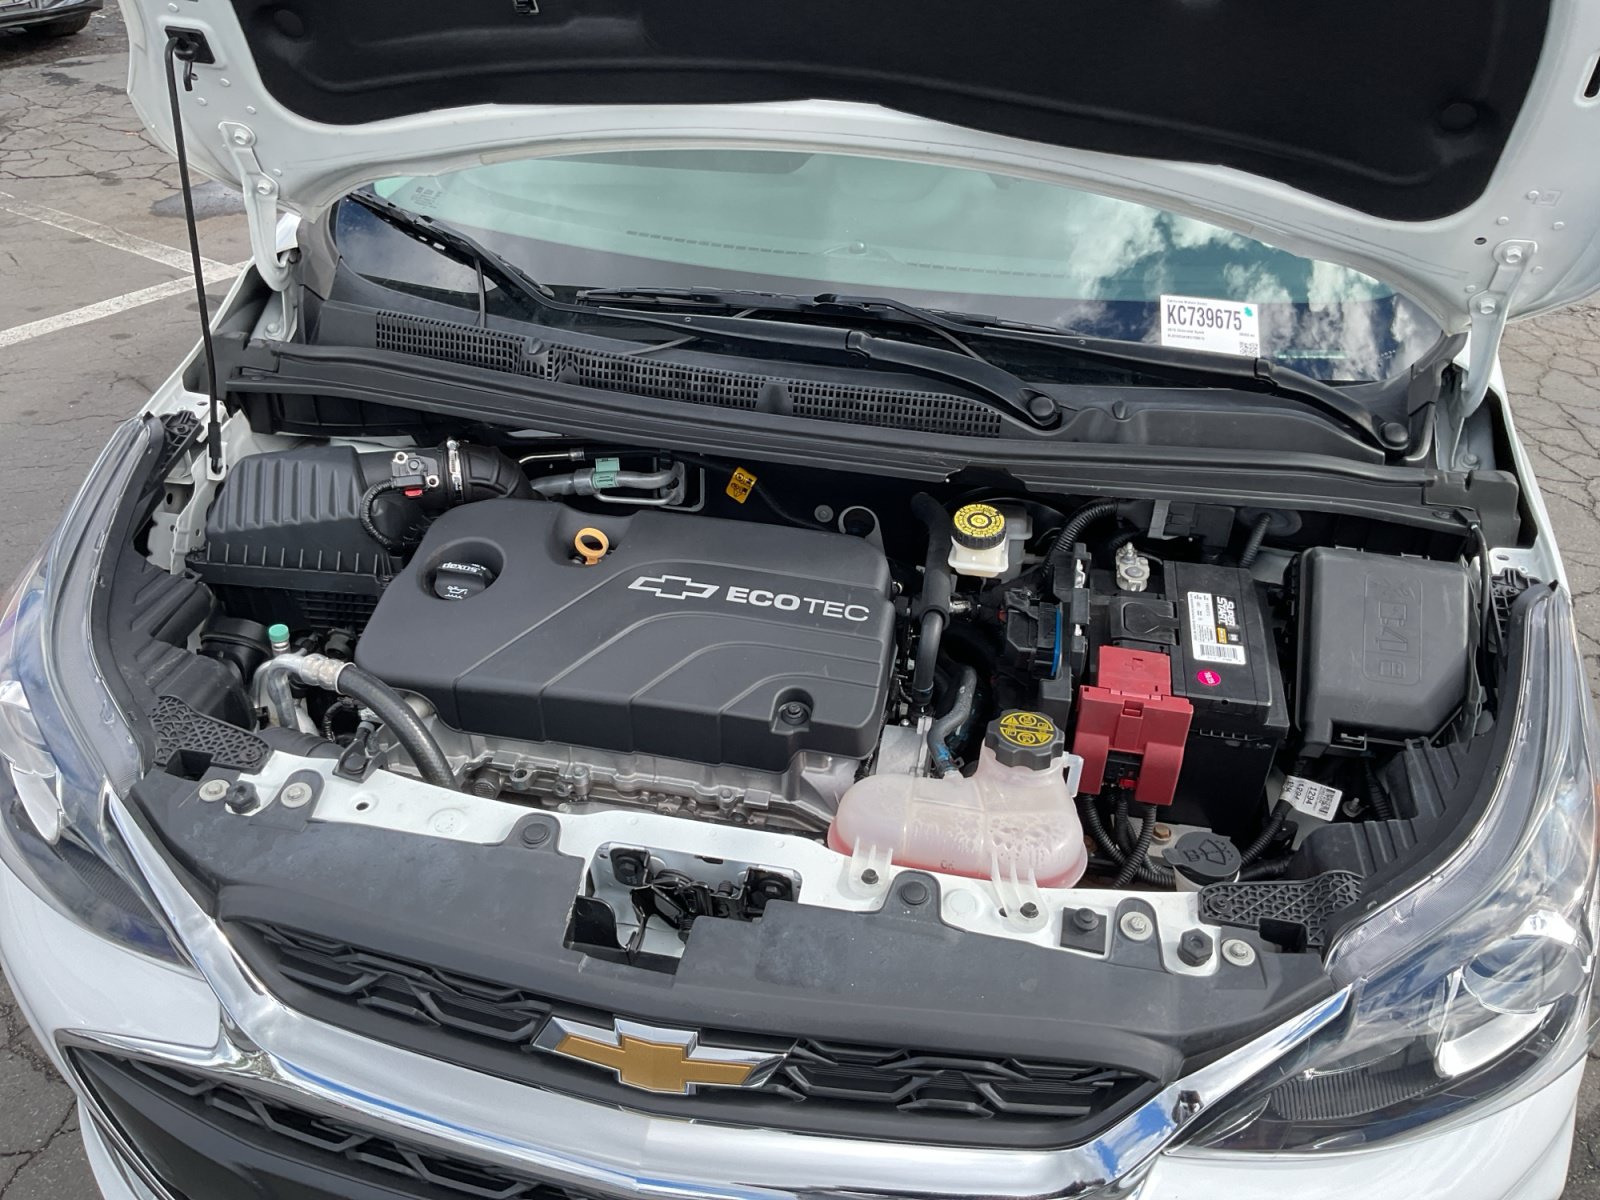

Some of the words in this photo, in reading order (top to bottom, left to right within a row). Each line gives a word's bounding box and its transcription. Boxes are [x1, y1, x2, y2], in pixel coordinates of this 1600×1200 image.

[1167, 304, 1242, 331] KC739675
[442, 562, 478, 573] dexos
[725, 586, 870, 622] ECOTEC
[1216, 596, 1228, 625] START
[1226, 600, 1236, 626] SUPER
[1305, 787, 1318, 805] 1294
